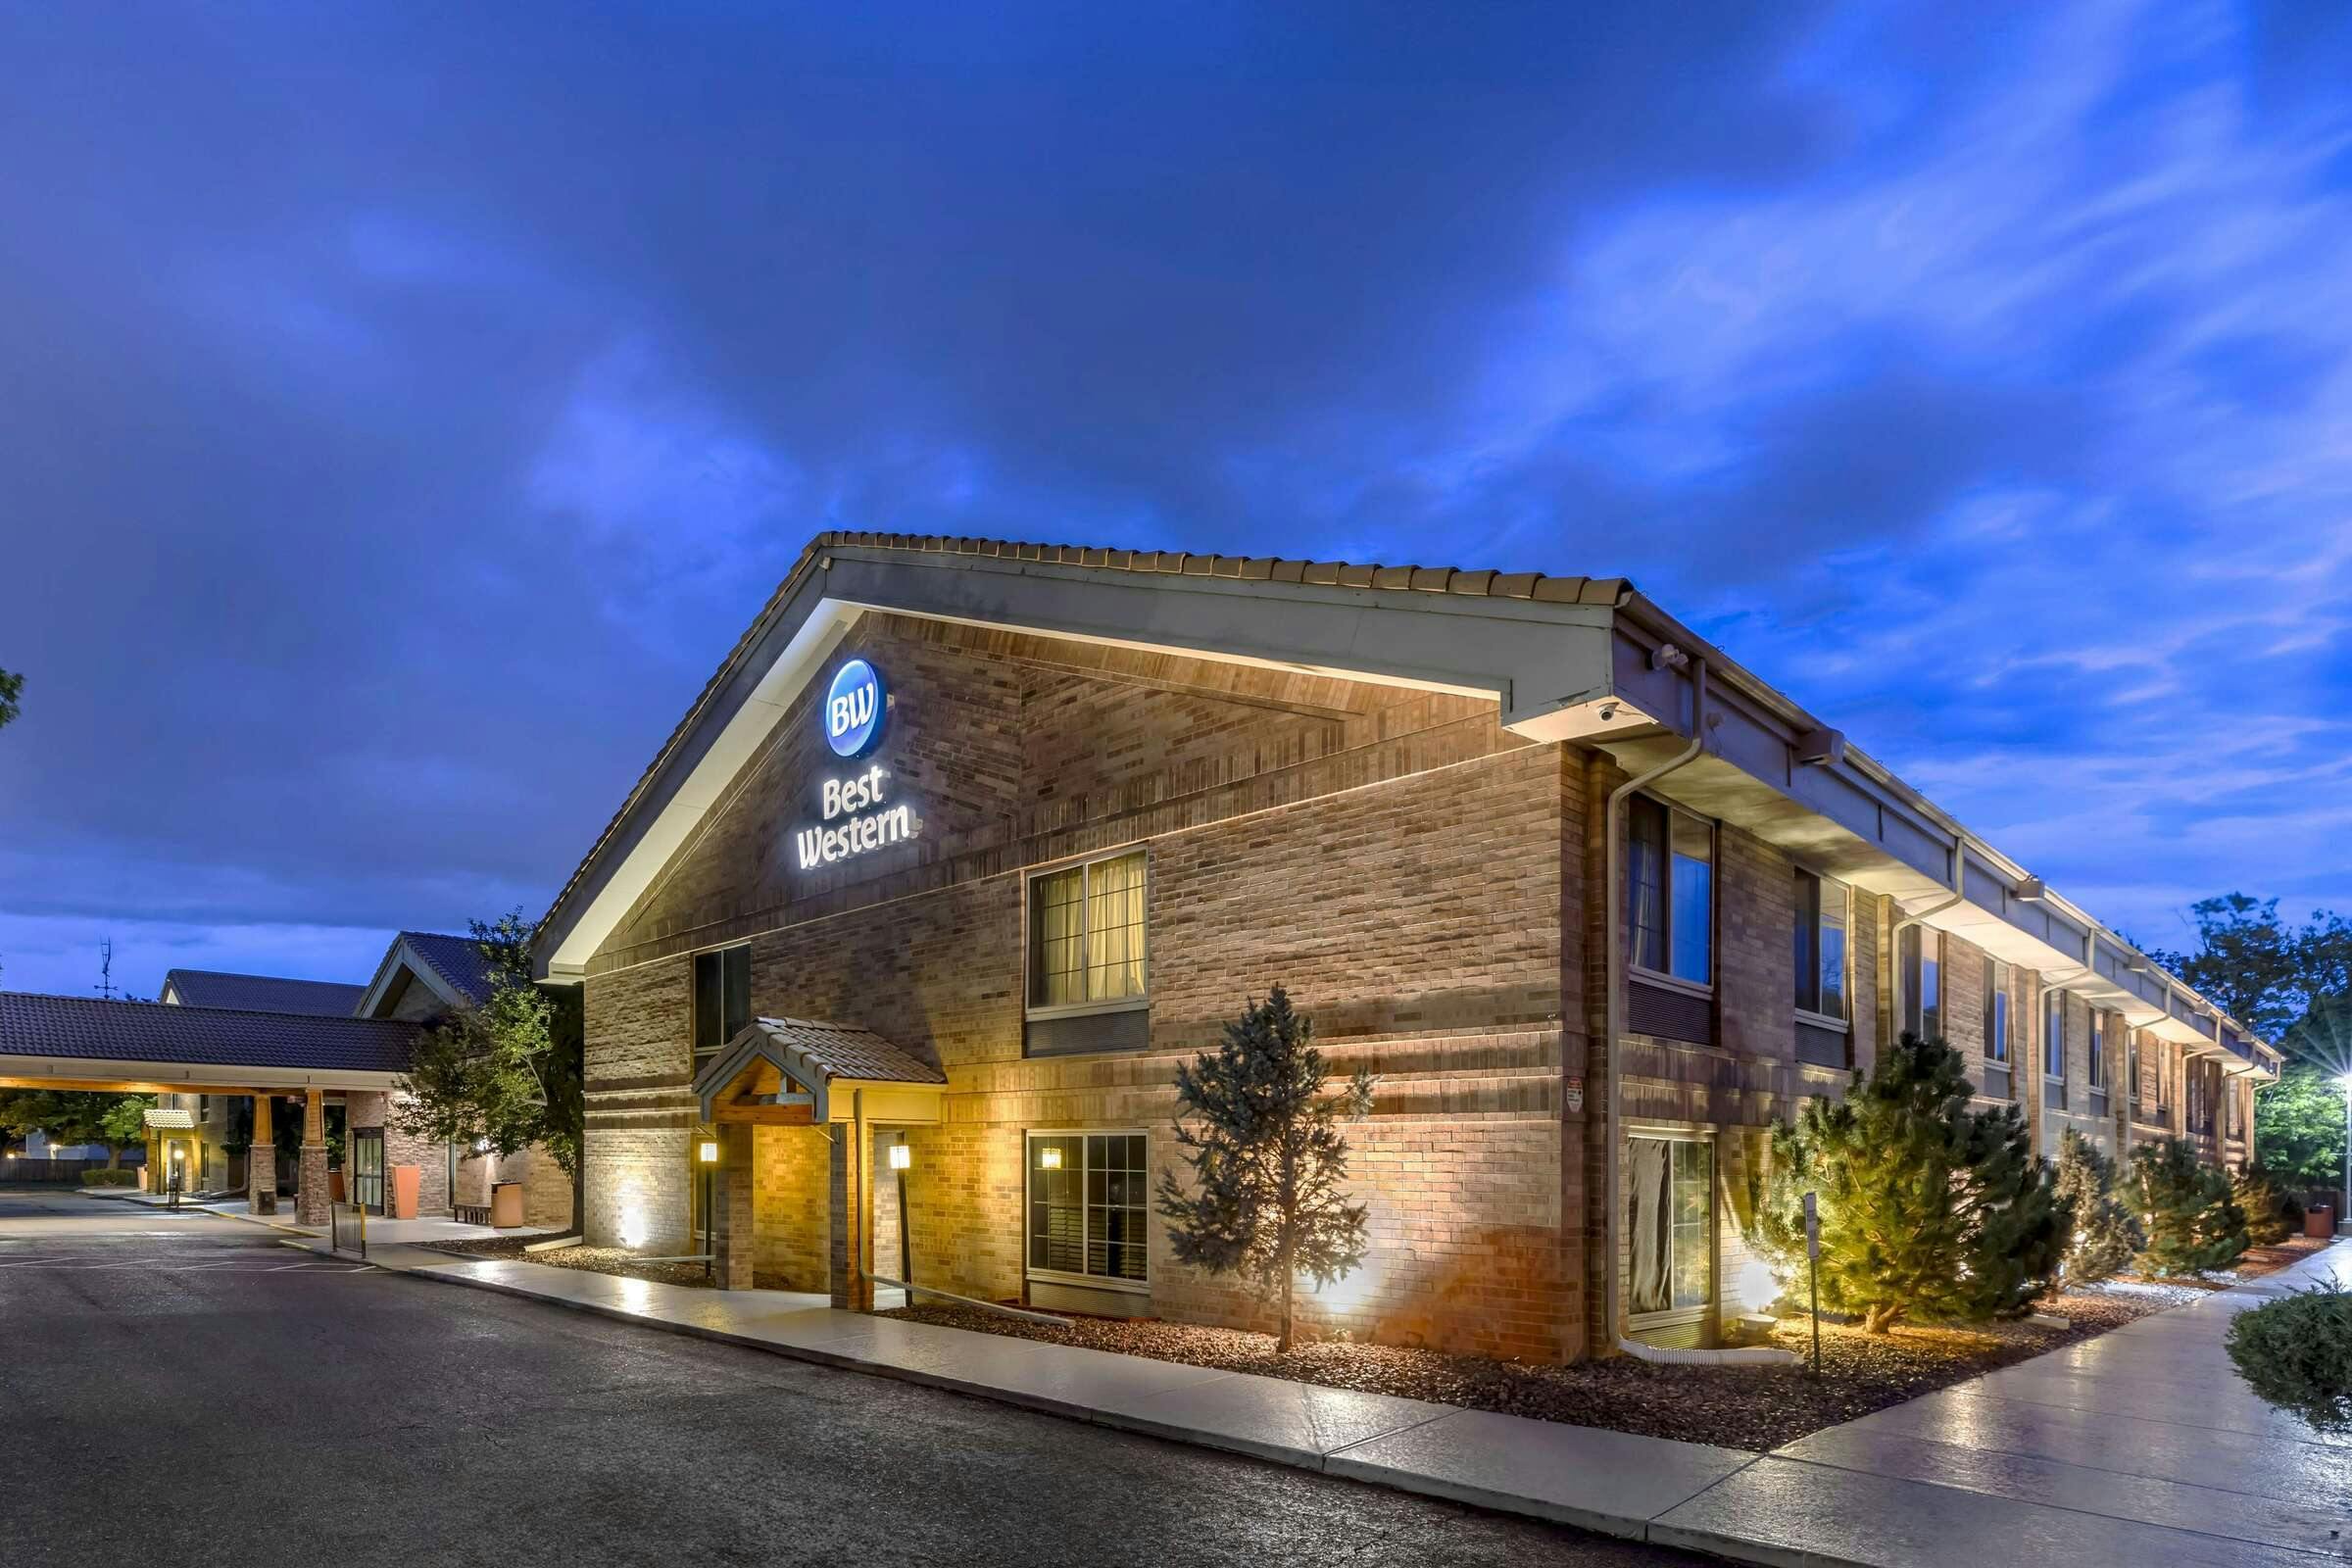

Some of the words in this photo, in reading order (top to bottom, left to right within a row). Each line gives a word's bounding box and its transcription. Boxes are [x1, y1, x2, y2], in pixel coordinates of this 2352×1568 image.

[832, 682, 873, 737] BW
[823, 765, 883, 820] Best
[797, 805, 909, 869] Western
